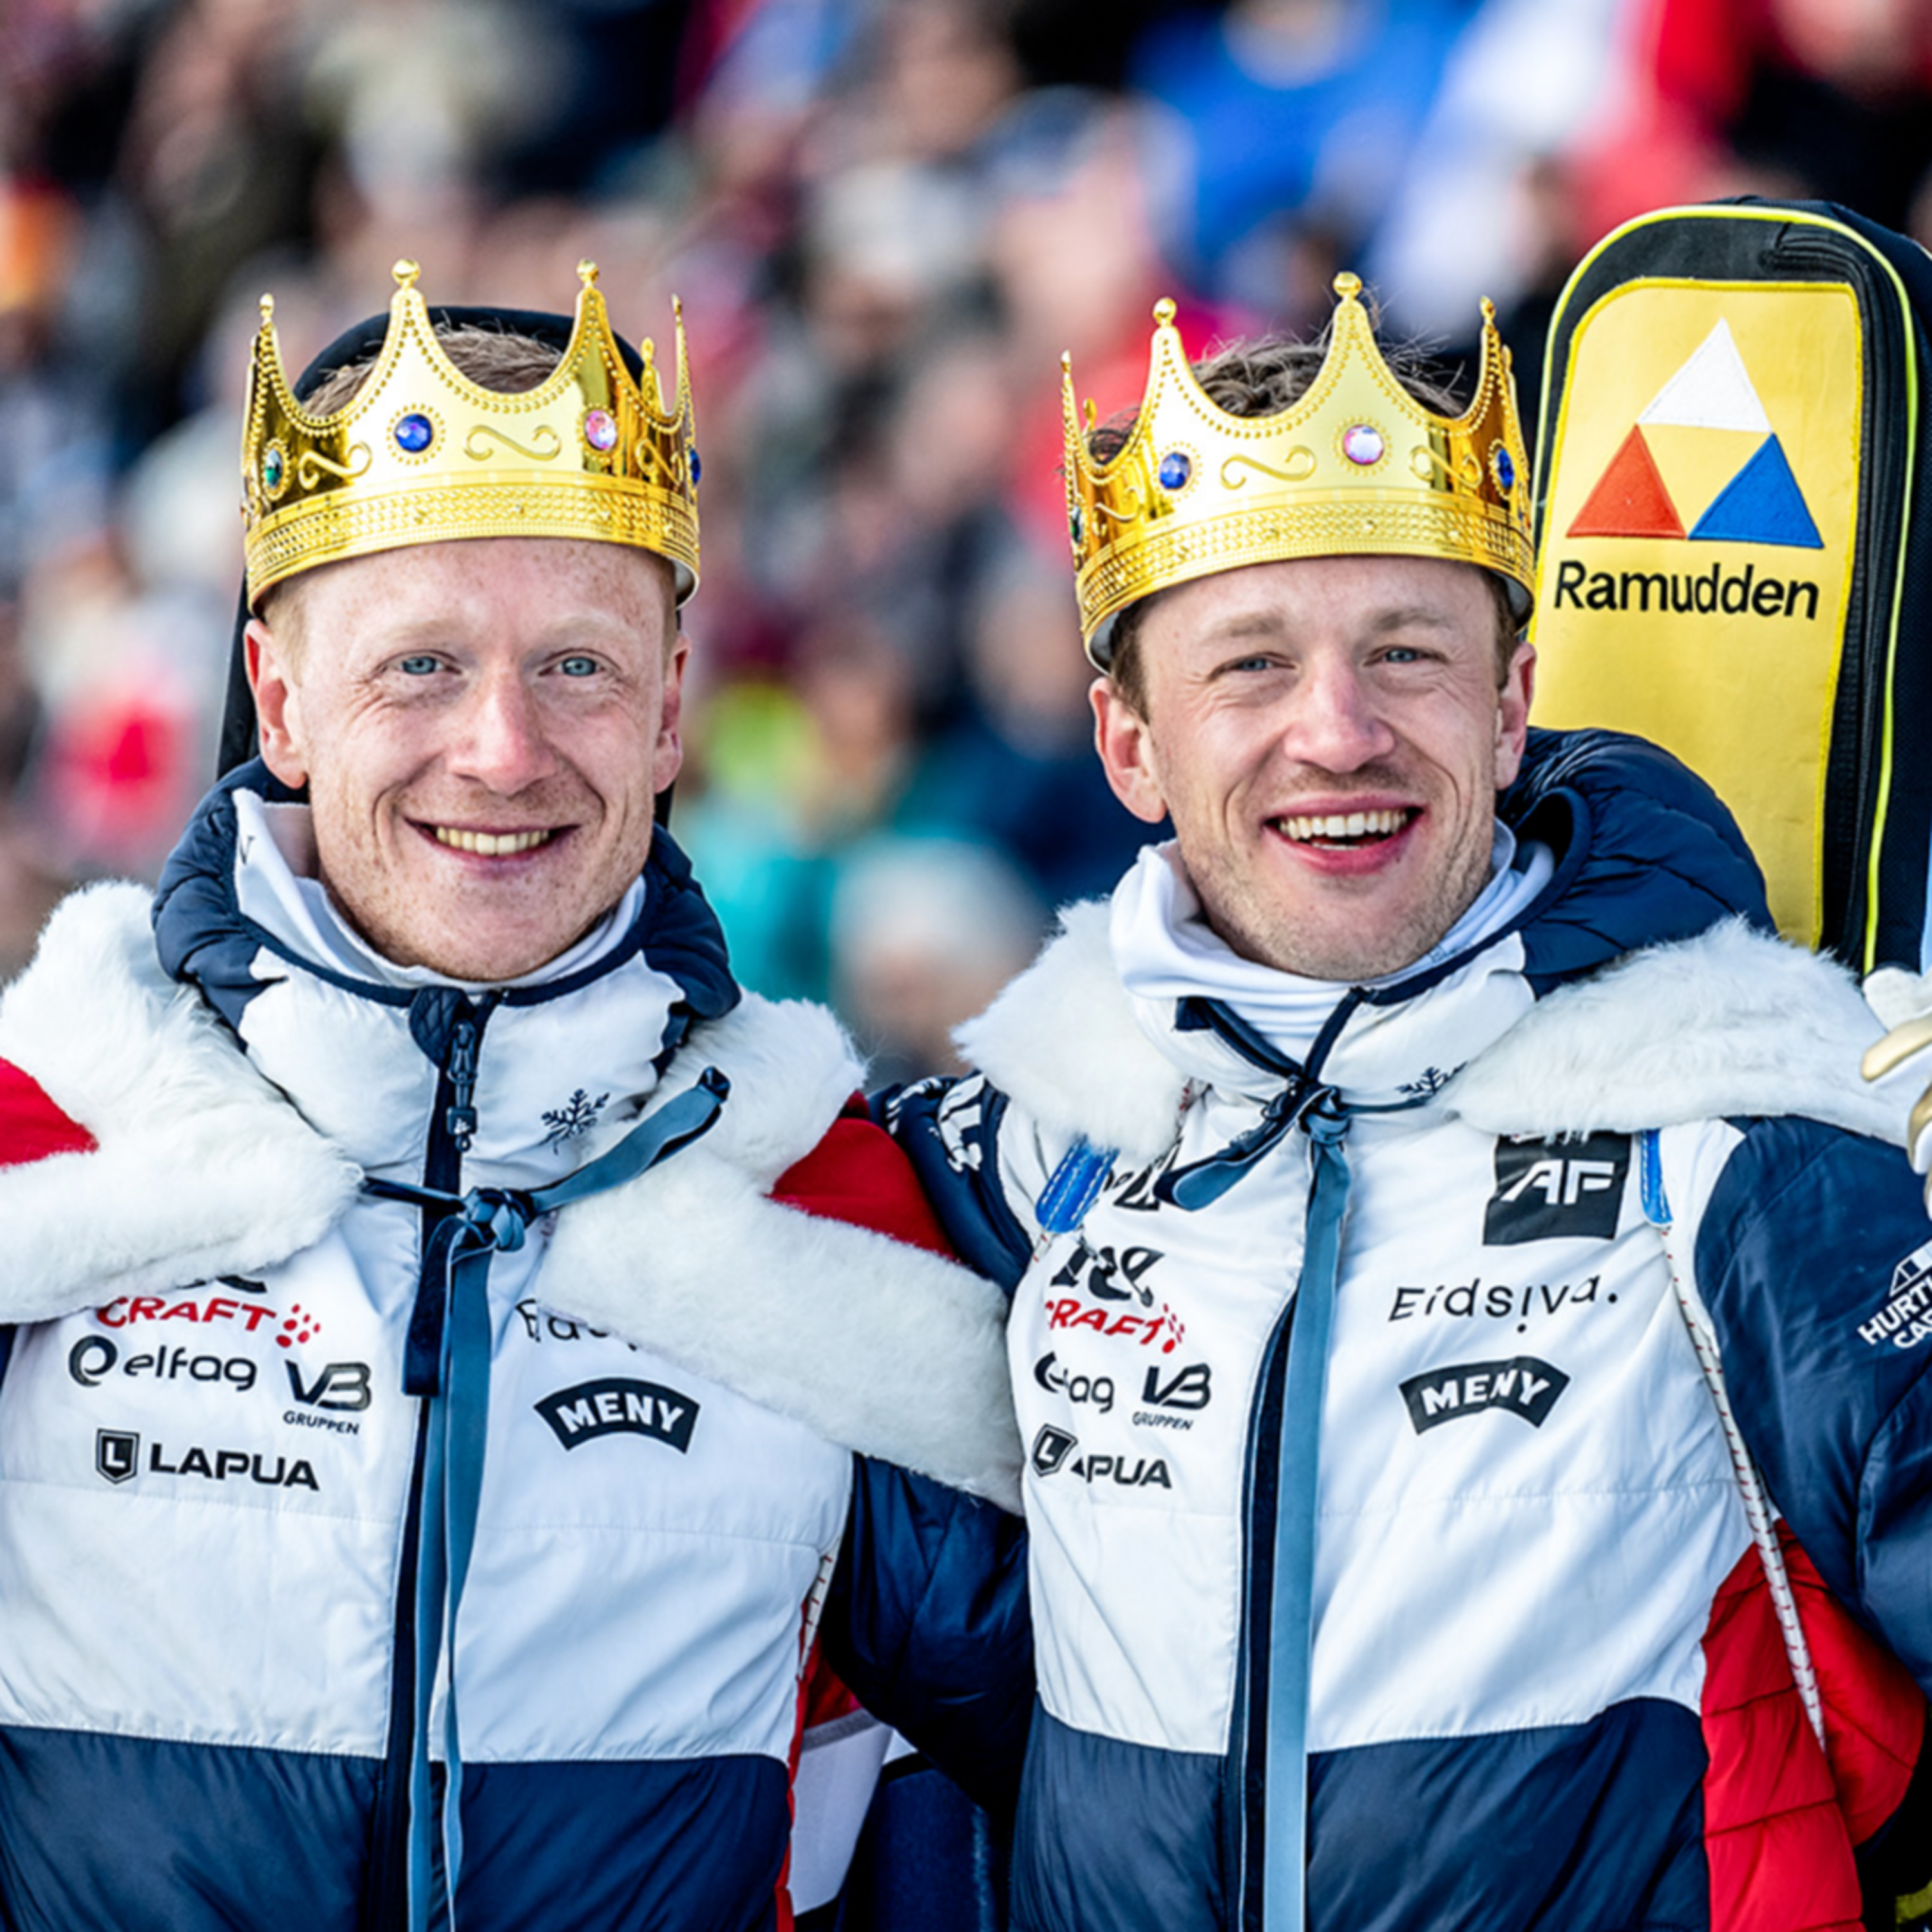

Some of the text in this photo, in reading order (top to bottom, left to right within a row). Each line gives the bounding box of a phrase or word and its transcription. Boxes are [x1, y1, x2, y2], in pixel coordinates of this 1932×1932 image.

[1553, 560, 1819, 620] Ramudden
[1500, 1159, 1615, 1206] AF
[95, 1296, 277, 1331] CRAFT
[1045, 1298, 1166, 1345] RAFT
[122, 1345, 257, 1392] elfag
[284, 1359, 372, 1412] VB
[1142, 1363, 1211, 1410] VB
[556, 1392, 685, 1434] MENY
[1421, 1369, 1550, 1416] MENY
[283, 1410, 359, 1435] GRUPPEN
[1132, 1412, 1194, 1431] GRUPPEN
[149, 1443, 320, 1491] LAPUA
